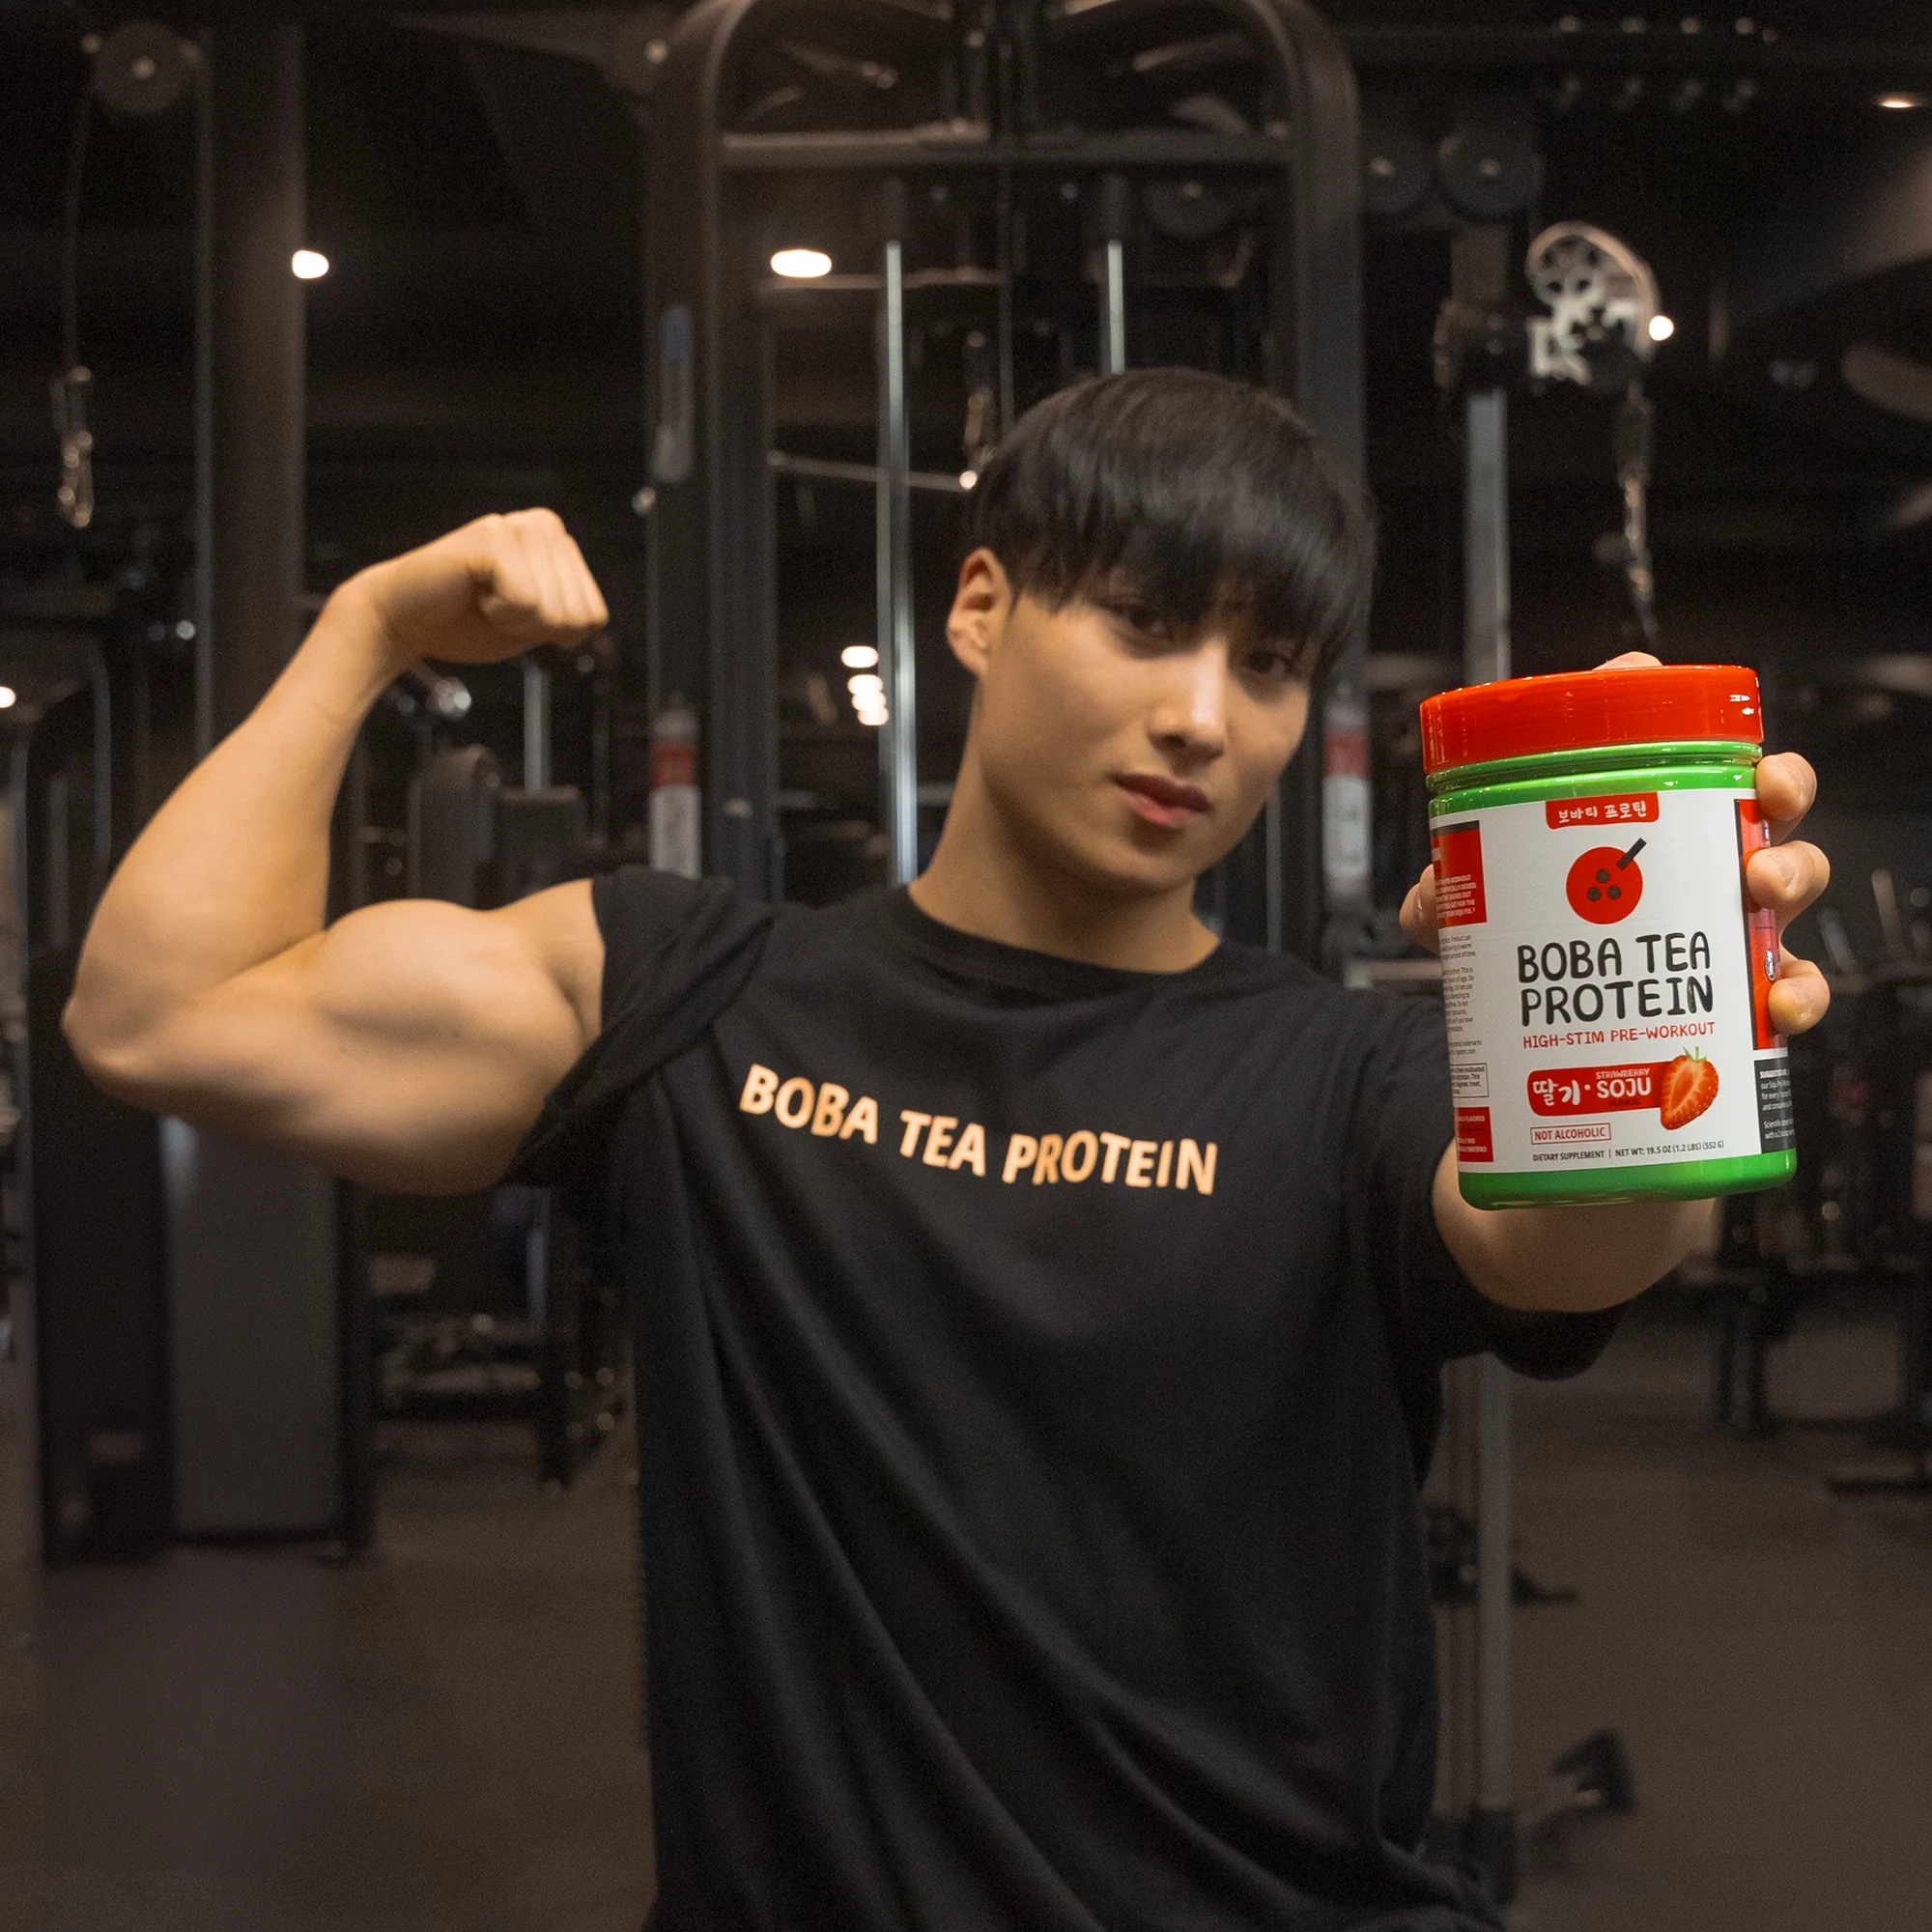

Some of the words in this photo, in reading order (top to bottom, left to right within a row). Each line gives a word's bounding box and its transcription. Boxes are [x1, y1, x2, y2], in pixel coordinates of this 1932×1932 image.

[1558, 806, 1598, 824] 보바티
[1605, 800, 1647, 818] 프로틴
[1518, 937, 1623, 983] BOBA
[1635, 931, 1711, 974] TEA
[1520, 975, 1714, 1027] PROTEIN
[1522, 1030, 1605, 1048] HIGH-STIM
[1610, 1021, 1716, 1042] PRE-WORKOUT
[1595, 1067, 1650, 1080] STRAWBERRY
[1532, 1078, 1581, 1106] 딸기
[1596, 1077, 1651, 1098] SOJU
[739, 1063, 878, 1145] BOBA
[899, 1109, 986, 1178] TEA
[1002, 1129, 1218, 1195] PROTEIN
[1534, 1130, 1552, 1140] NOT
[1554, 1127, 1605, 1139] ALCOHOLIC
[1532, 1152, 1558, 1161] DIETARY
[1560, 1150, 1605, 1160] SUPPLEMENT
[1615, 1149, 1629, 1157] NET
[1631, 1148, 1644, 1156] WT:
[1672, 1144, 1686, 1152] (1.2
[1687, 1142, 1701, 1151] LBS)
